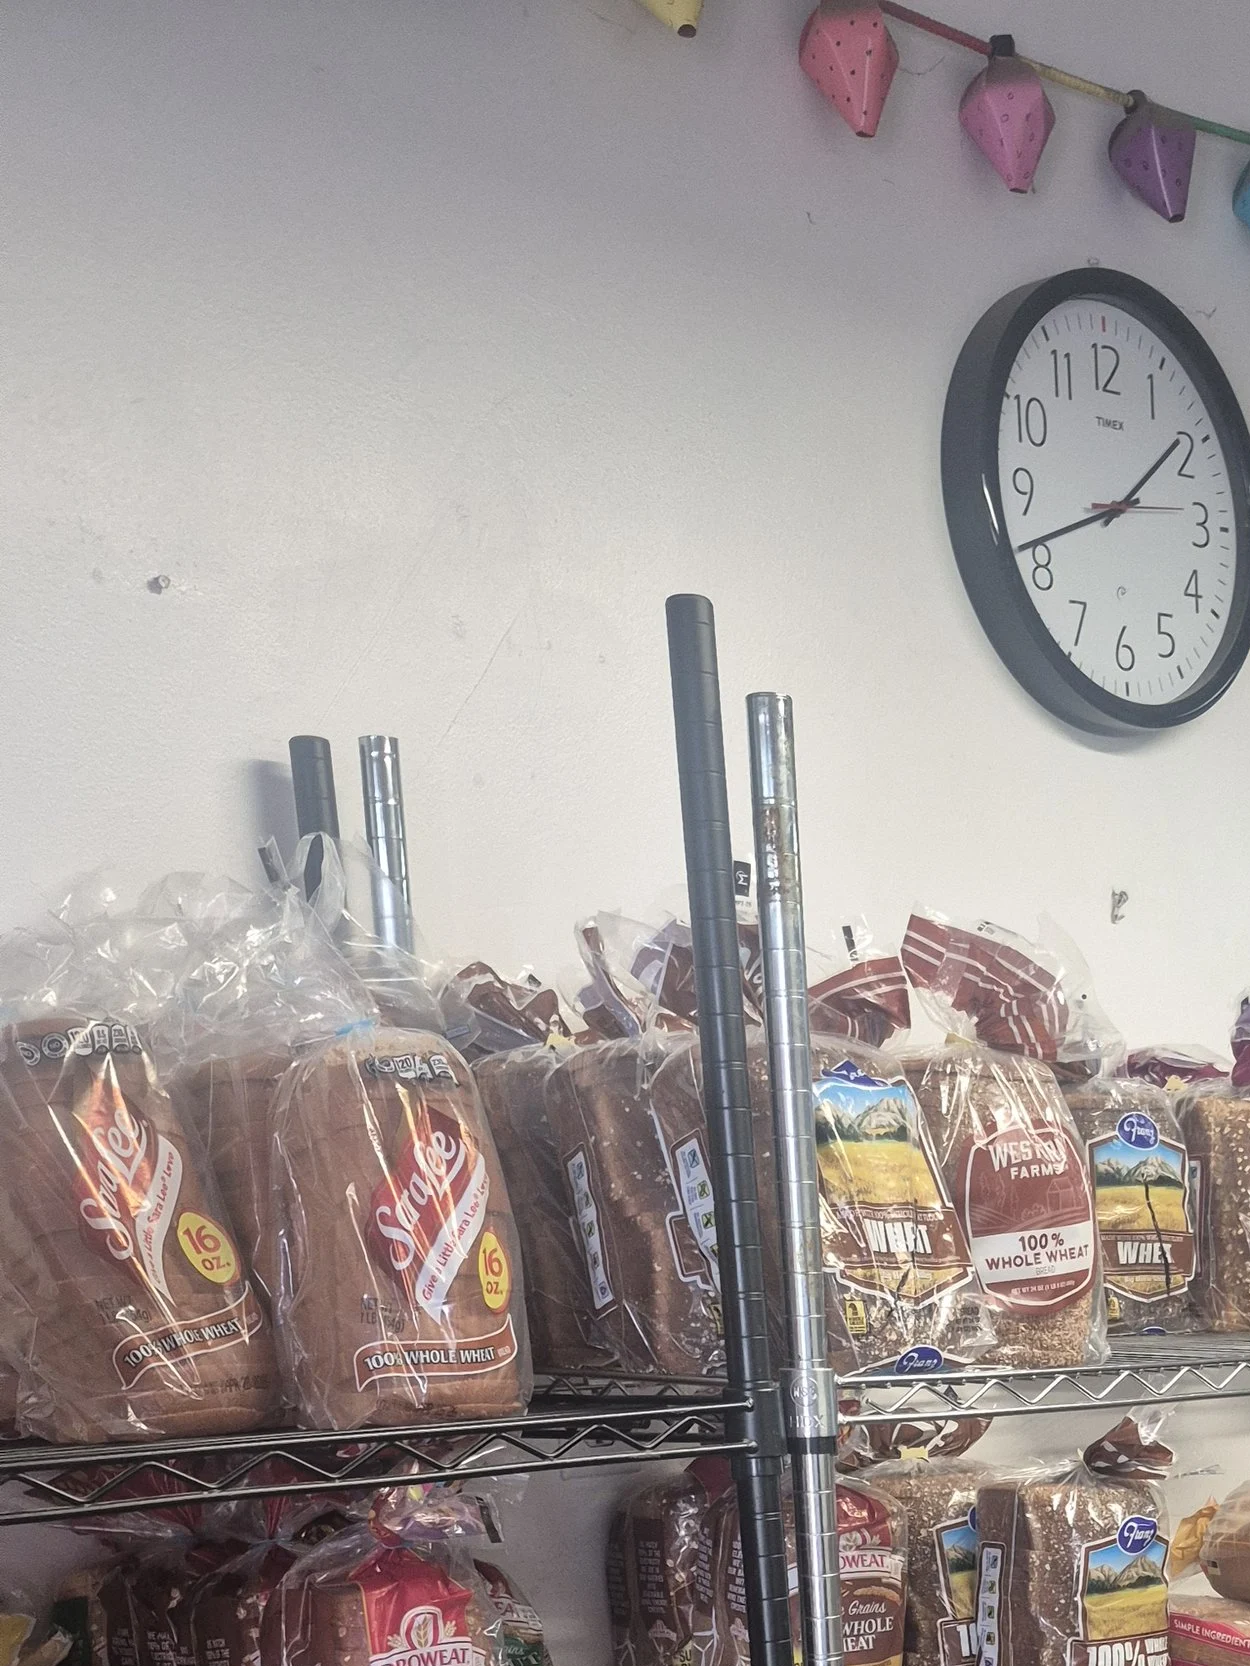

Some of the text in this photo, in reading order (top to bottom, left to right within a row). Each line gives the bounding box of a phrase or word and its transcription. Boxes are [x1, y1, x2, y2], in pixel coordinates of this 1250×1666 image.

[1050, 349, 1073, 400] 11
[1091, 342, 1121, 395] 12
[1147, 373, 1155, 420] 1
[1014, 394, 1047, 446] 10
[1095, 415, 1124, 431] TIMEX
[1175, 431, 1195, 478] 2
[1012, 467, 1034, 516] 9
[1192, 502, 1210, 547] 3
[1032, 543, 1054, 590] 8
[1183, 569, 1203, 614] 4
[1069, 599, 1087, 646] 7
[1157, 612, 1175, 658] 5
[1115, 625, 1136, 671] 6
[183, 1226, 221, 1256] 16
[482, 1247, 503, 1277] 16
[985, 1244, 1089, 1270] WHOLE WHEAT
[1018, 1233, 1048, 1252] 100
[423, 1274, 438, 1301] Give
[123, 1317, 242, 1368] 100% WHOLE WHEAT
[364, 1346, 495, 1371] 100% WHOLE WHEAT
[848, 1601, 887, 1616] Grains
[1174, 1619, 1200, 1635] SIMPLE
